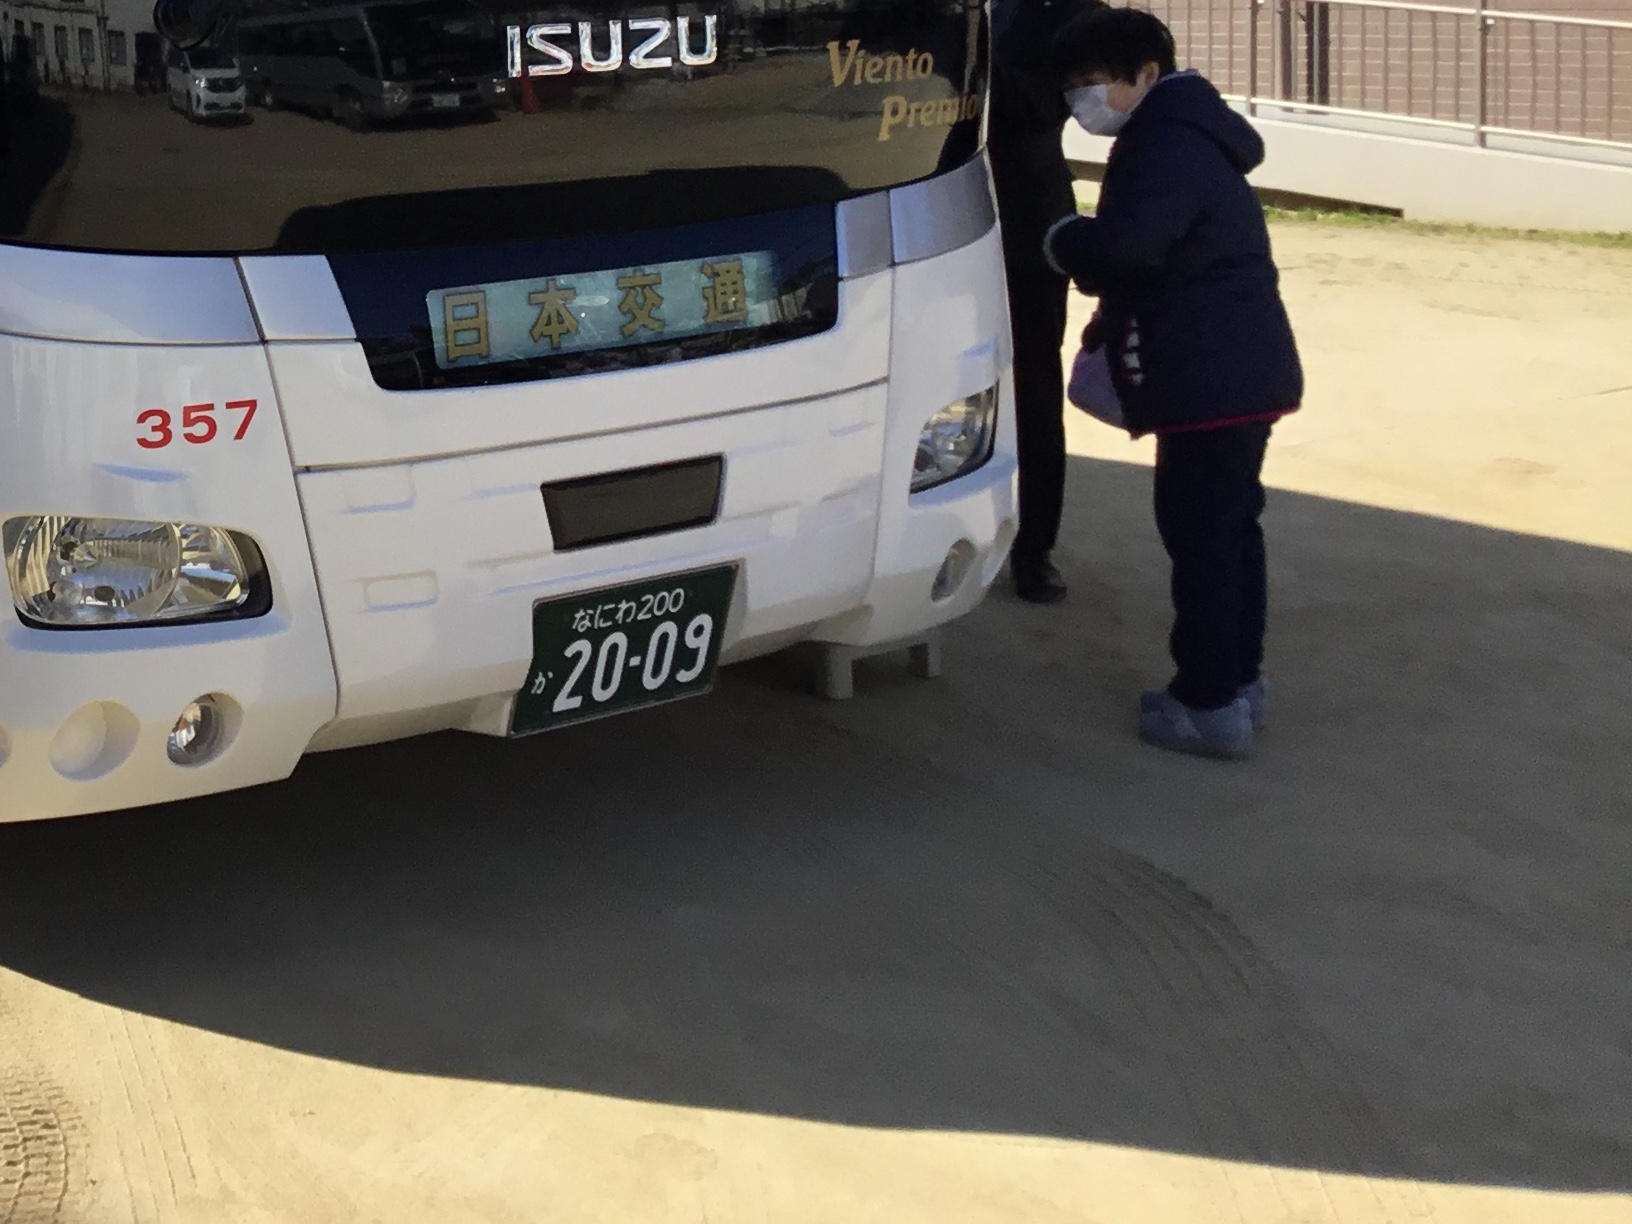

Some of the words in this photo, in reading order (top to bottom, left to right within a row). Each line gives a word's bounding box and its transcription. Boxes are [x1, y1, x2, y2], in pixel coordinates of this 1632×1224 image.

[506, 13, 718, 78] ISUZU
[826, 39, 934, 88] Viento
[877, 95, 977, 142] Premio
[442, 257, 749, 363] 日本交通
[136, 399, 257, 449] 357
[572, 587, 685, 633] なにわ200
[552, 613, 713, 713] 20-09
